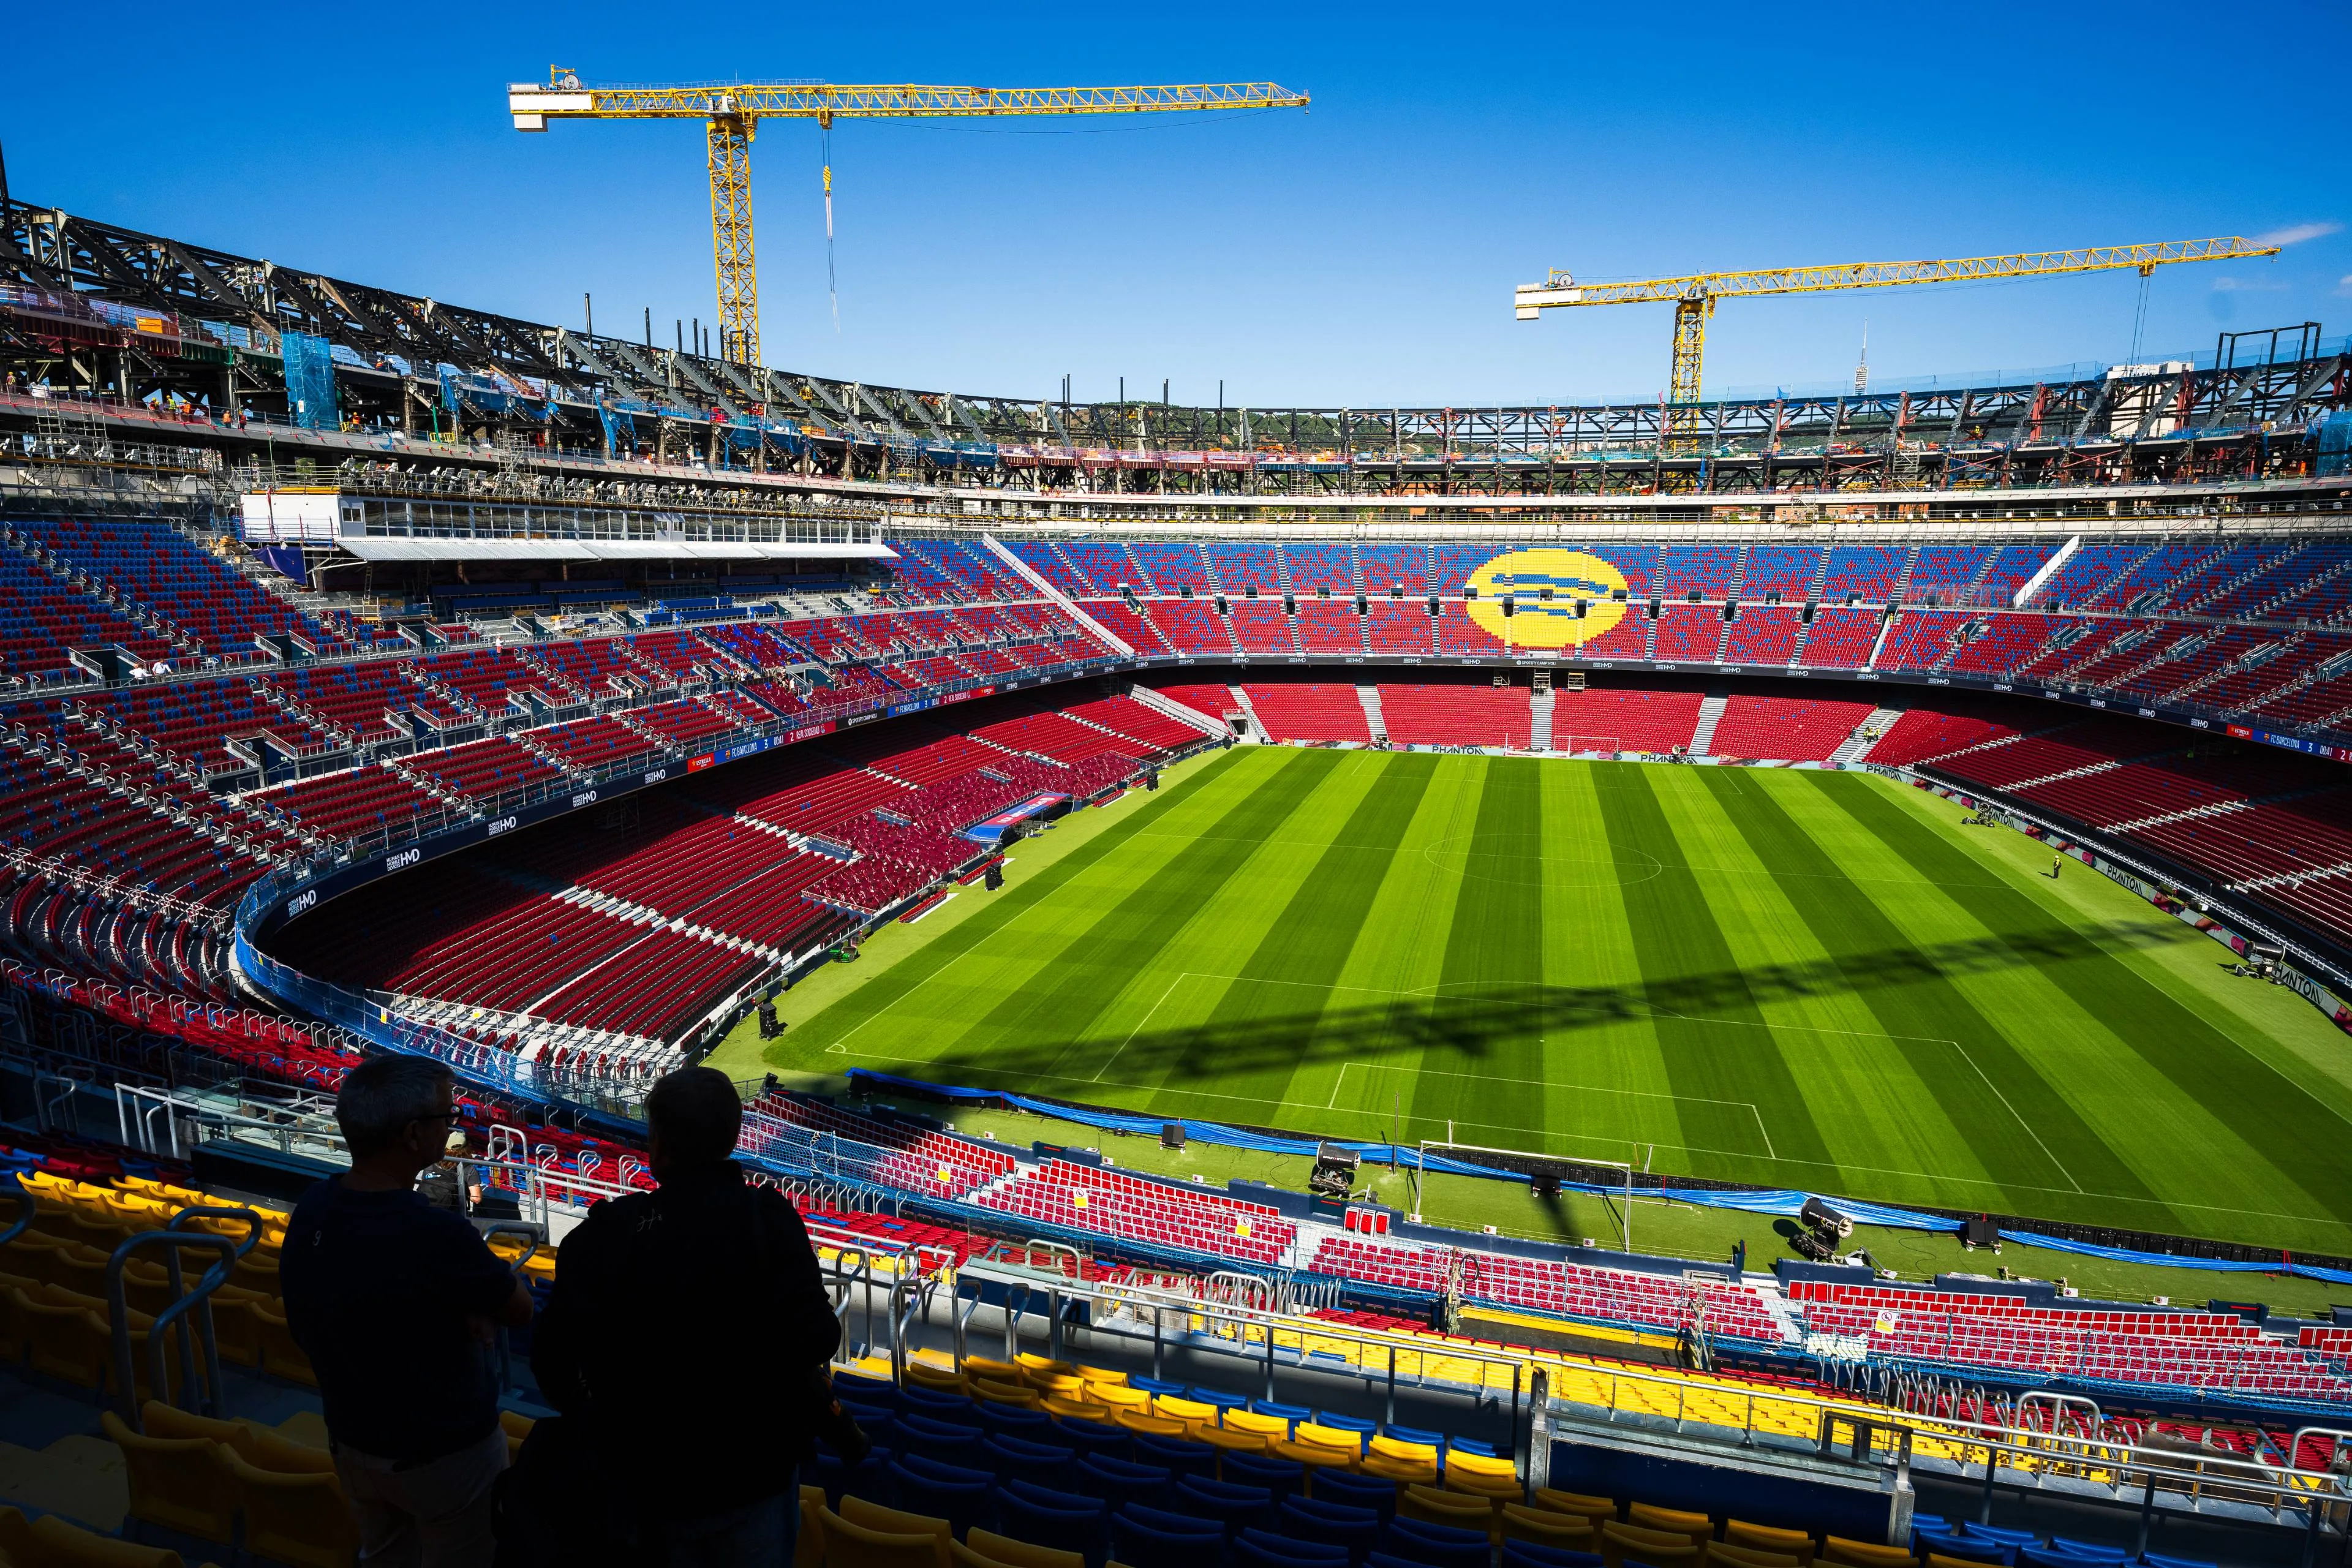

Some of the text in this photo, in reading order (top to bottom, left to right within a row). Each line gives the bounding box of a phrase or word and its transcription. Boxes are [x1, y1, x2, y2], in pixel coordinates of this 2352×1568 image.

[732, 748, 737, 758] FC
[737, 742, 757, 756] BARCELONA
[764, 739, 768, 749] 3
[774, 735, 784, 746] 00:41
[790, 733, 794, 742] 2
[804, 726, 820, 737] SOCIEDAD
[1432, 746, 1485, 755] PHANTOM
[2277, 736, 2300, 748] BARCELONA
[2308, 742, 2313, 752] 3
[2320, 745, 2332, 756] 00:41
[2340, 750, 2346, 760] 2
[696, 757, 711, 766] ESTRELLA
[654, 769, 665, 781] HMD
[1867, 765, 1902, 782] PHANTOM
[582, 790, 597, 804] HMD
[500, 816, 516, 832] HMD
[1989, 809, 2015, 828] HANTOM
[387, 859, 401, 867] MOBILE
[400, 848, 420, 866] HMD
[387, 863, 401, 872] DEVICES
[2107, 864, 2143, 895] PHANTOM
[299, 889, 316, 911] HMD
[2274, 965, 2320, 1005] HANTOM
